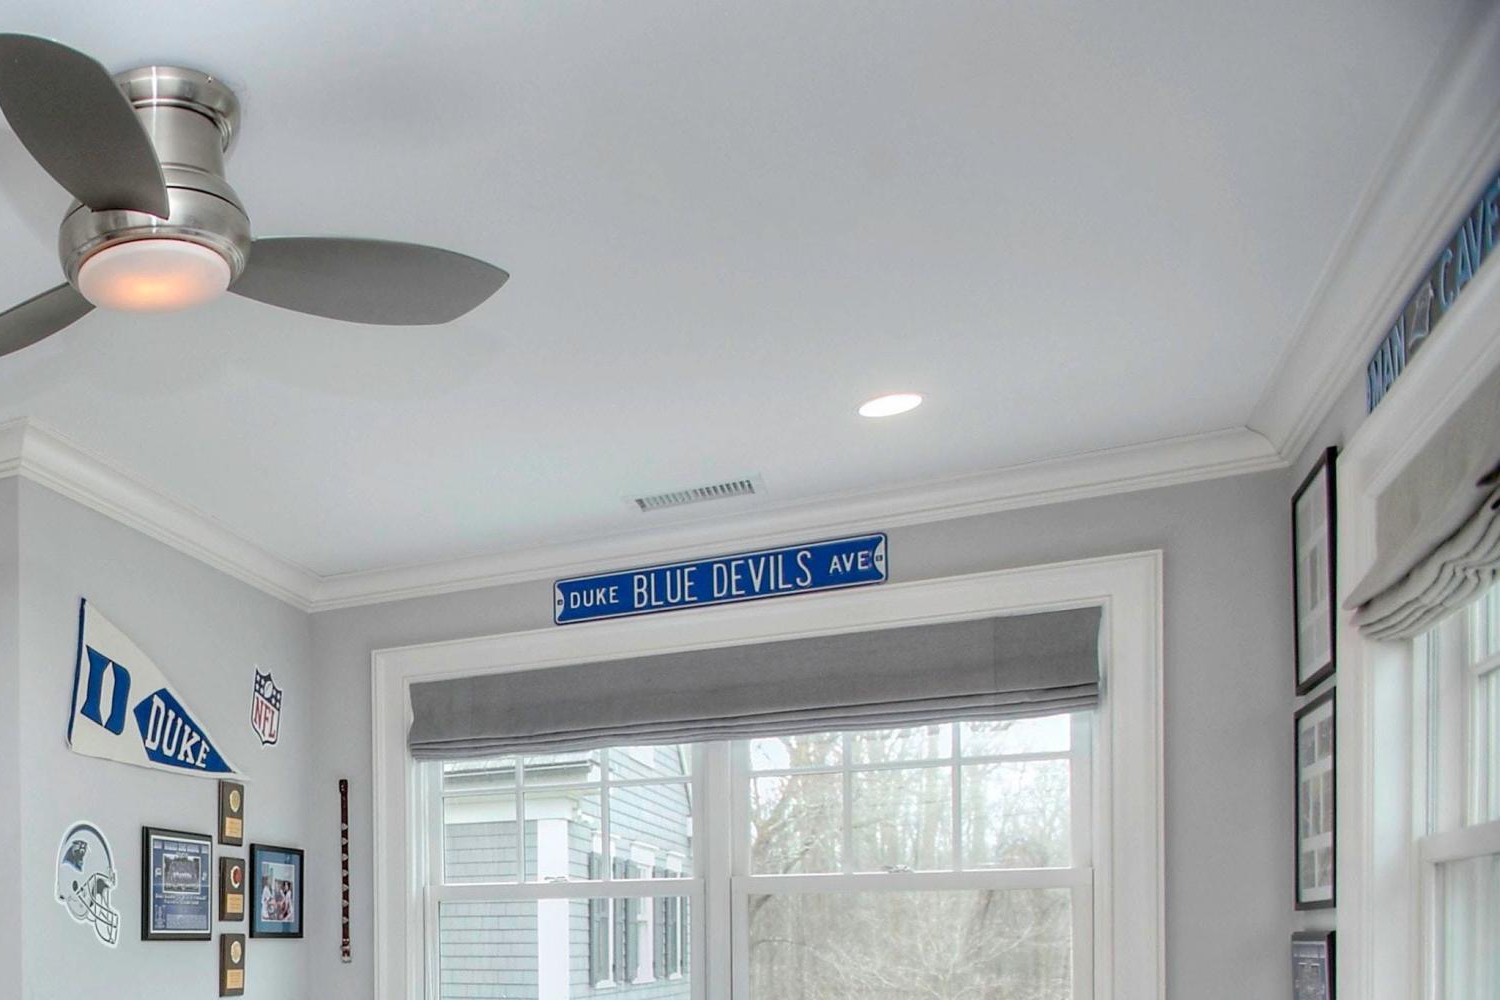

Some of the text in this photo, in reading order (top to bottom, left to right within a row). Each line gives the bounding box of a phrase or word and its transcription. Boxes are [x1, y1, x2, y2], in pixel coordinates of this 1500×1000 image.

[1364, 312, 1406, 416] MAN
[569, 551, 871, 609] DUKE BLUE DEVILS AVE
[145, 693, 210, 768] DUKE
[253, 696, 276, 738] NFL
